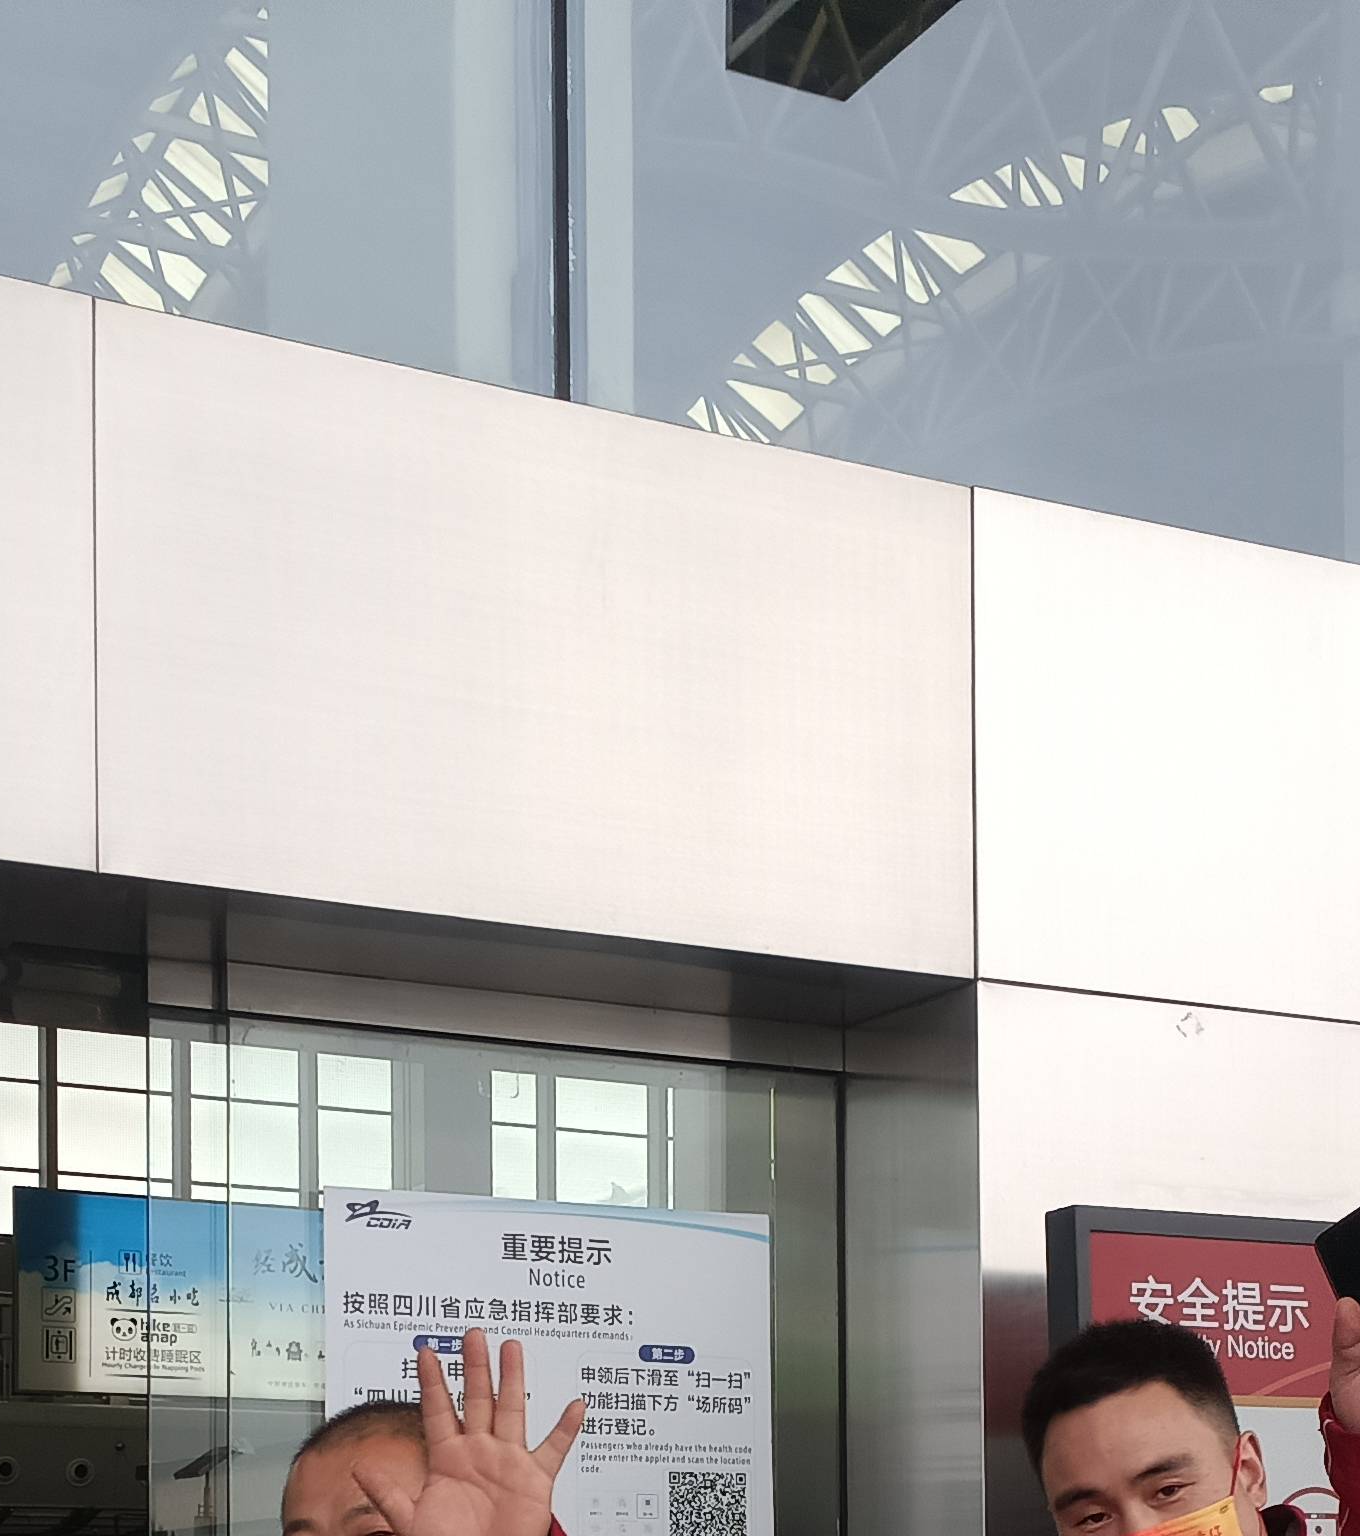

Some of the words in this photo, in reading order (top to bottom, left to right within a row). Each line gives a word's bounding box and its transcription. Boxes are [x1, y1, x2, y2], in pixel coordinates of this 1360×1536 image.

[501, 1233, 612, 1265] 重要提示
[43, 1255, 76, 1283] 3F
[528, 1268, 586, 1289] Notice
[1129, 1275, 1310, 1333] 安全提示
[344, 1320, 355, 1328] As
[357, 1320, 391, 1330] Sichuan
[394, 1321, 433, 1333] Epidemic
[502, 1327, 532, 1336] Control
[534, 1328, 590, 1340] Headquarters
[652, 1348, 685, 1361] 第二步
[1228, 1336, 1295, 1361] Notice
[581, 1441, 625, 1451] Passengers
[644, 1442, 673, 1453] already
[734, 1446, 752, 1454] code
[581, 1454, 606, 1465] please
[608, 1455, 629, 1463] enter
[720, 1457, 751, 1465] location
